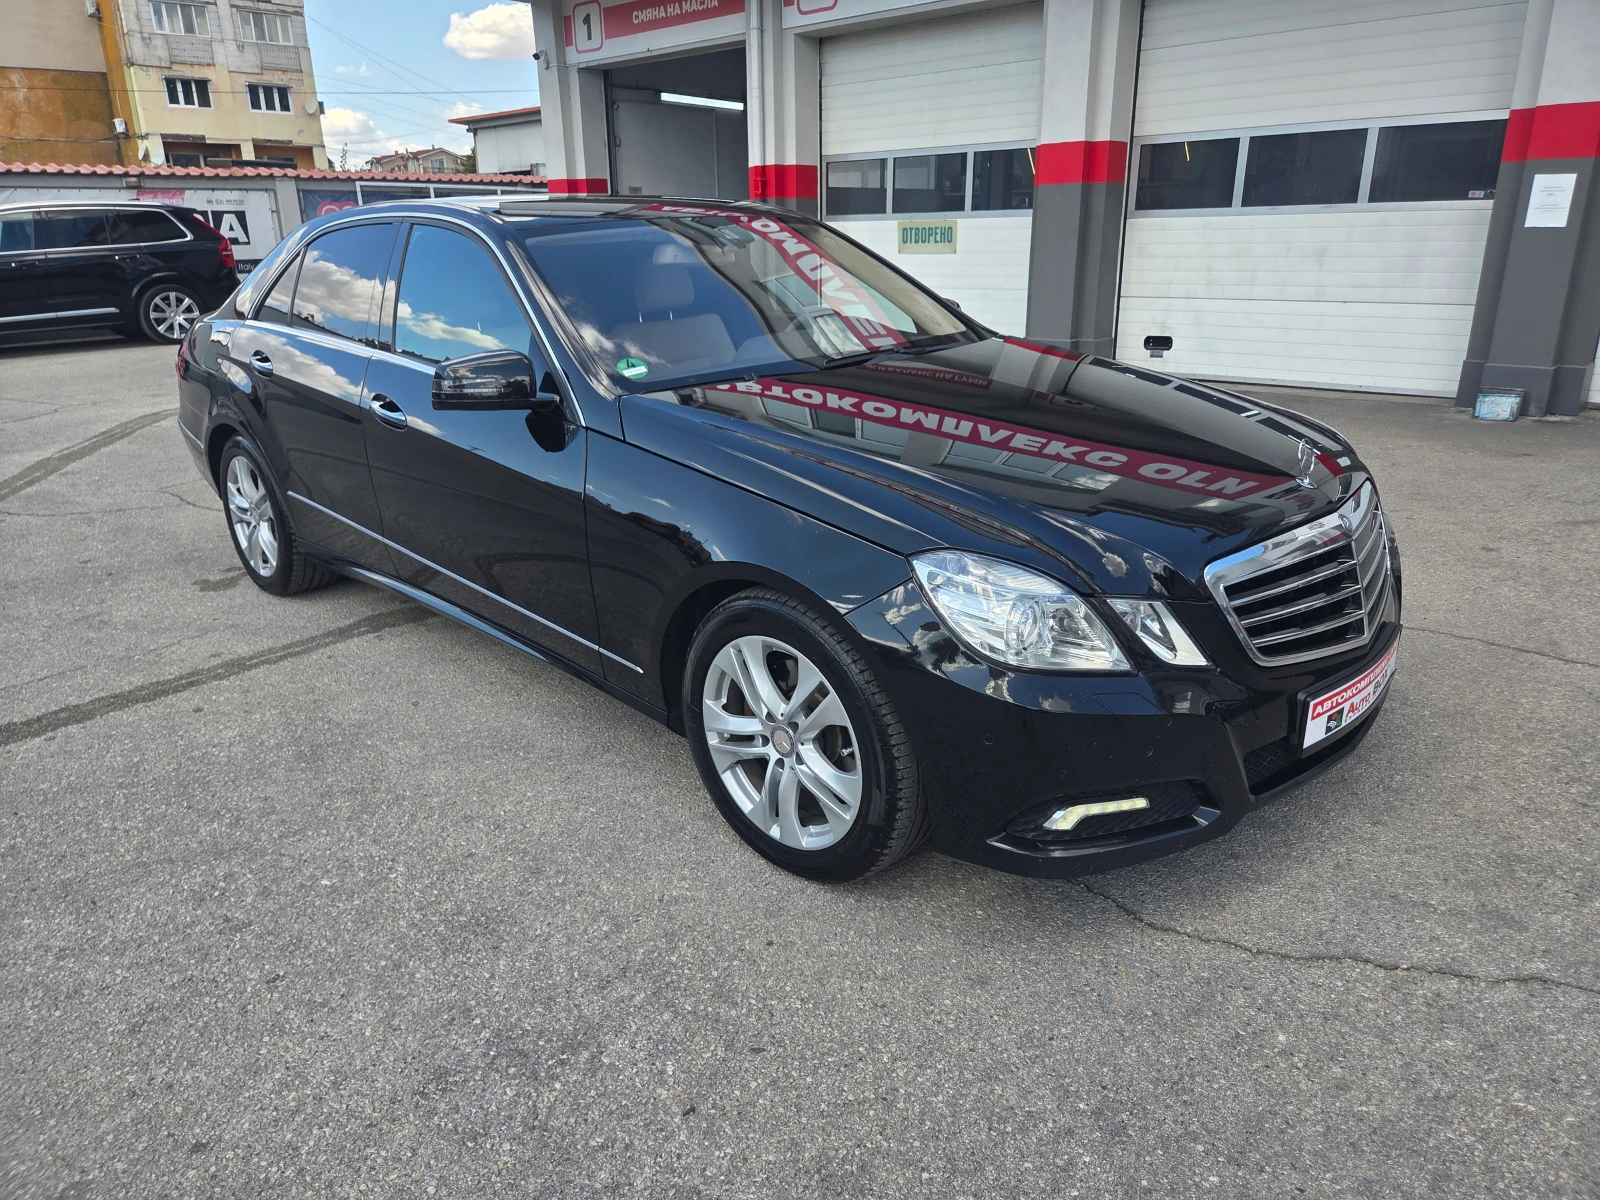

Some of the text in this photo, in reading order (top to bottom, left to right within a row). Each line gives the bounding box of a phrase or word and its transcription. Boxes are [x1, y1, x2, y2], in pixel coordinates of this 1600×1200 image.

[632, 6, 666, 24] СМЯНА
[667, 2, 681, 17] НА
[582, 12, 592, 41] 1
[902, 226, 953, 244] ОТВОРЕНО
